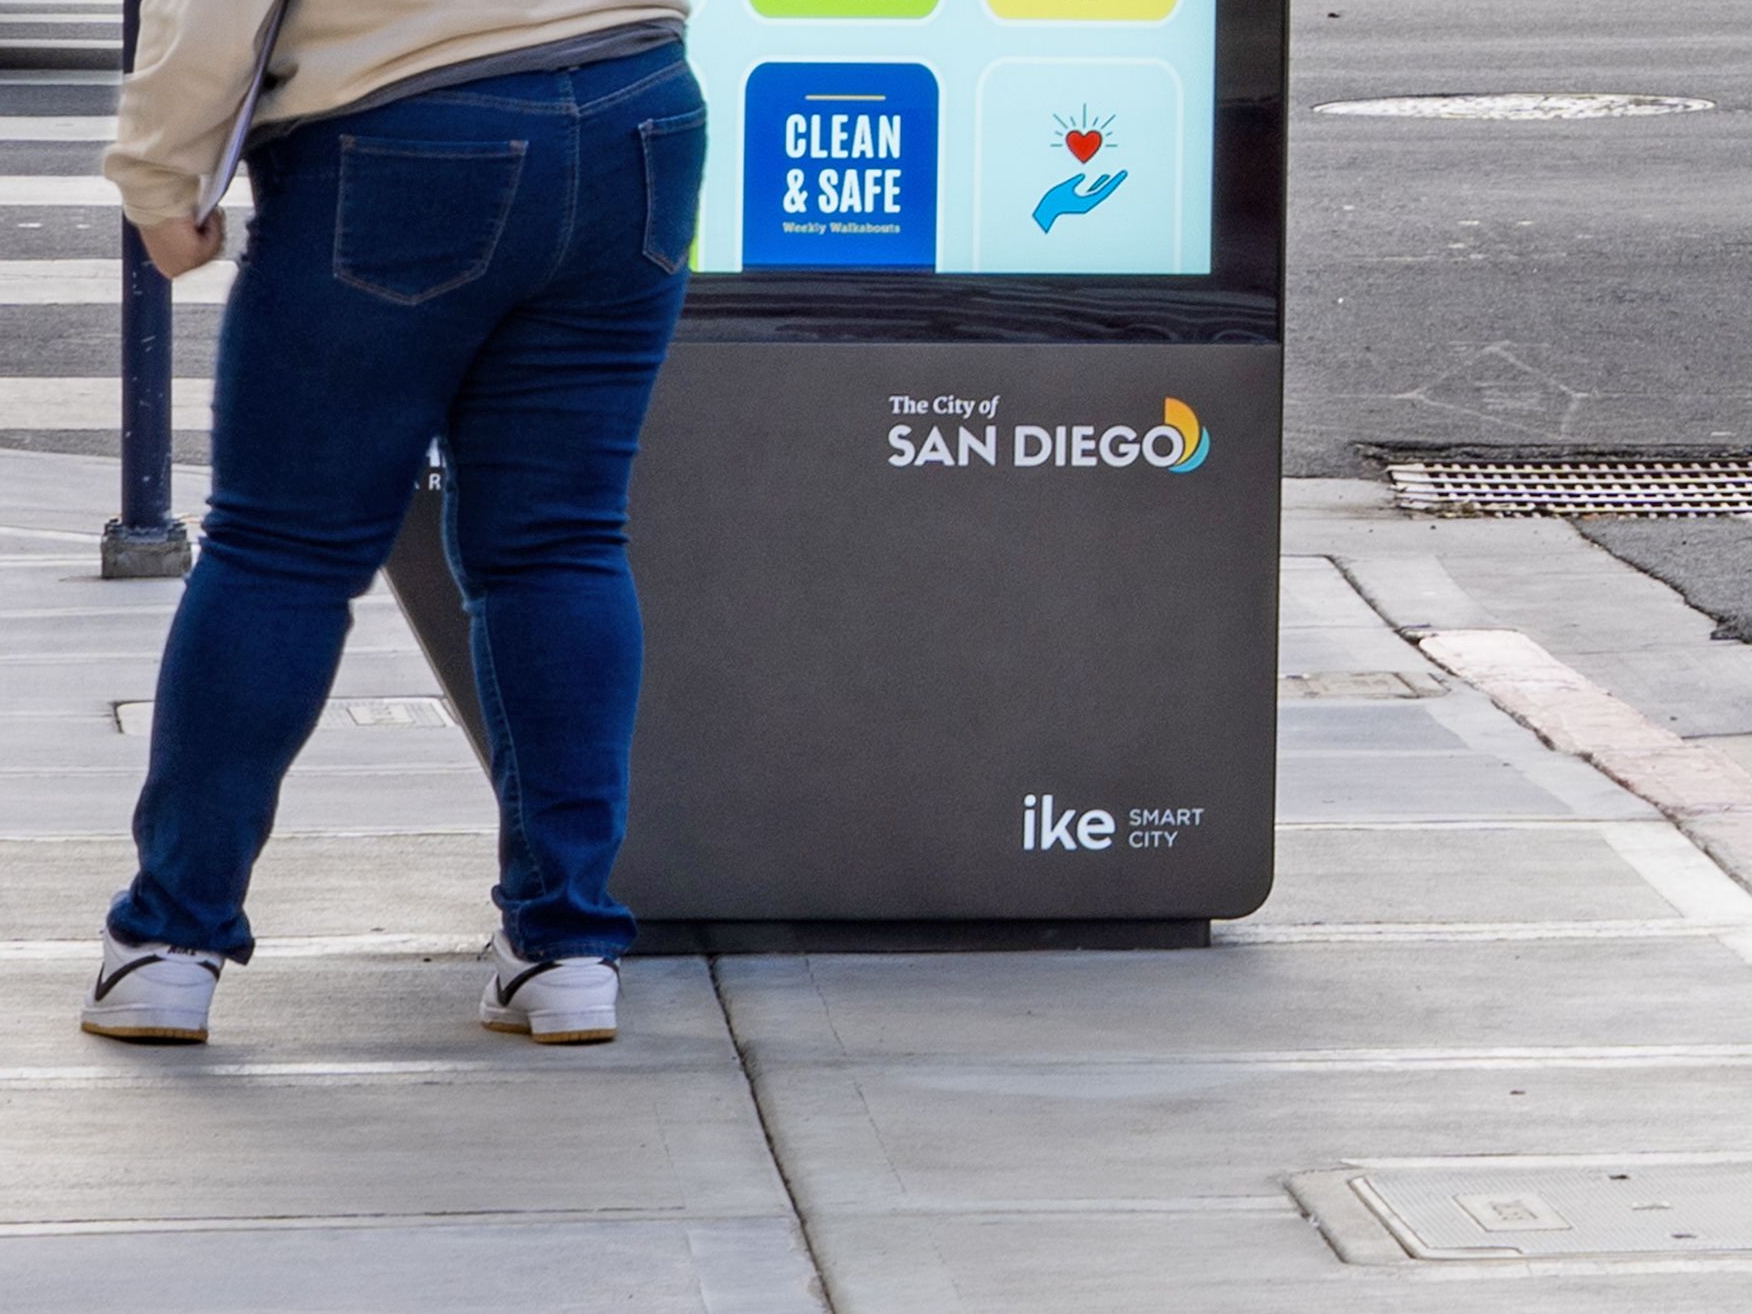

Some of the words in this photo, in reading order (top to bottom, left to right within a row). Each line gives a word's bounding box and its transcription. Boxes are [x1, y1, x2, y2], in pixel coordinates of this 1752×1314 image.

[785, 113, 902, 159] CLEAN
[782, 168, 808, 213] &
[818, 168, 902, 214] SAFE
[889, 395, 929, 414] The
[932, 394, 974, 420] City
[978, 395, 1001, 419] of
[888, 424, 997, 467] SAN
[1014, 425, 1185, 468] DIEGO
[1023, 794, 1117, 851] ike
[1128, 807, 1205, 826] SMART
[1128, 830, 1179, 849] CITY
